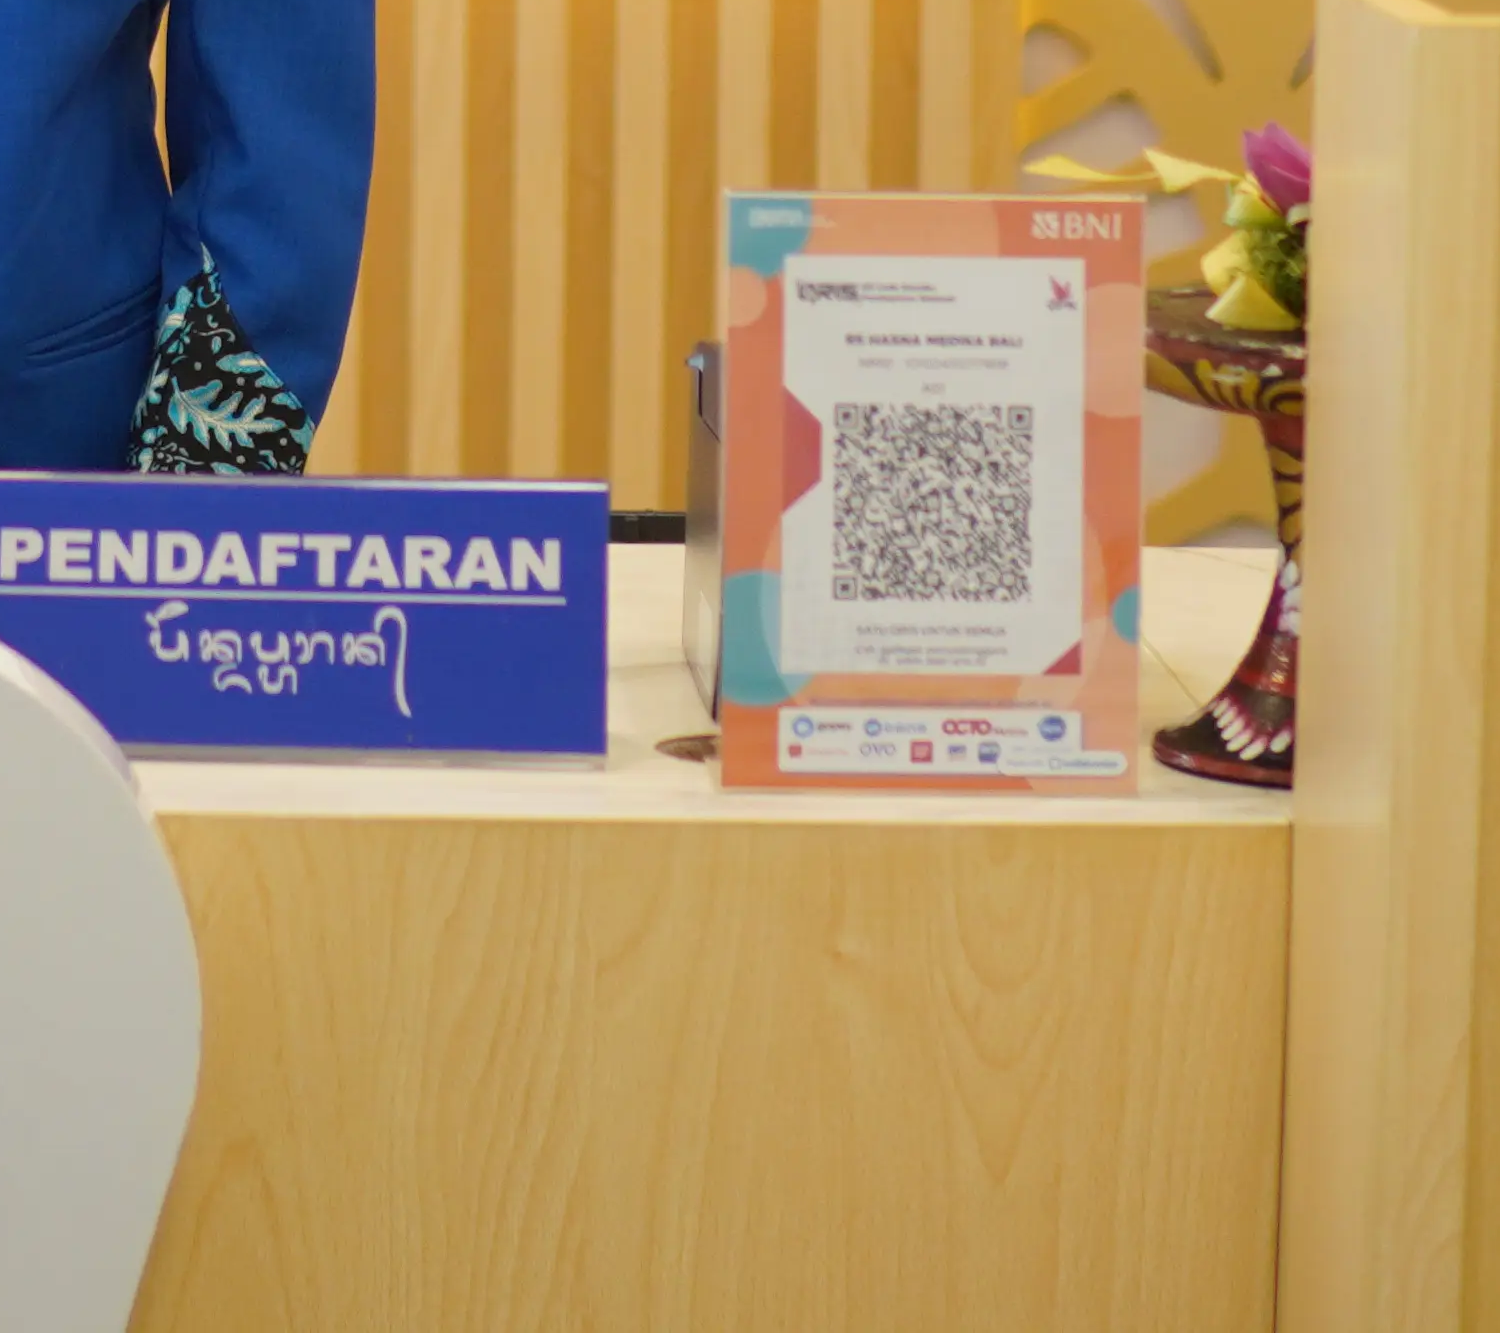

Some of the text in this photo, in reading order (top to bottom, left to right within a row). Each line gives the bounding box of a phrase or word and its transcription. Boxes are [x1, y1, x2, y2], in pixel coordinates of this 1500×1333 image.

[1064, 211, 1122, 240] BNI
[0, 526, 562, 592] PENDAFTARAN
[942, 719, 992, 736] OCTO
